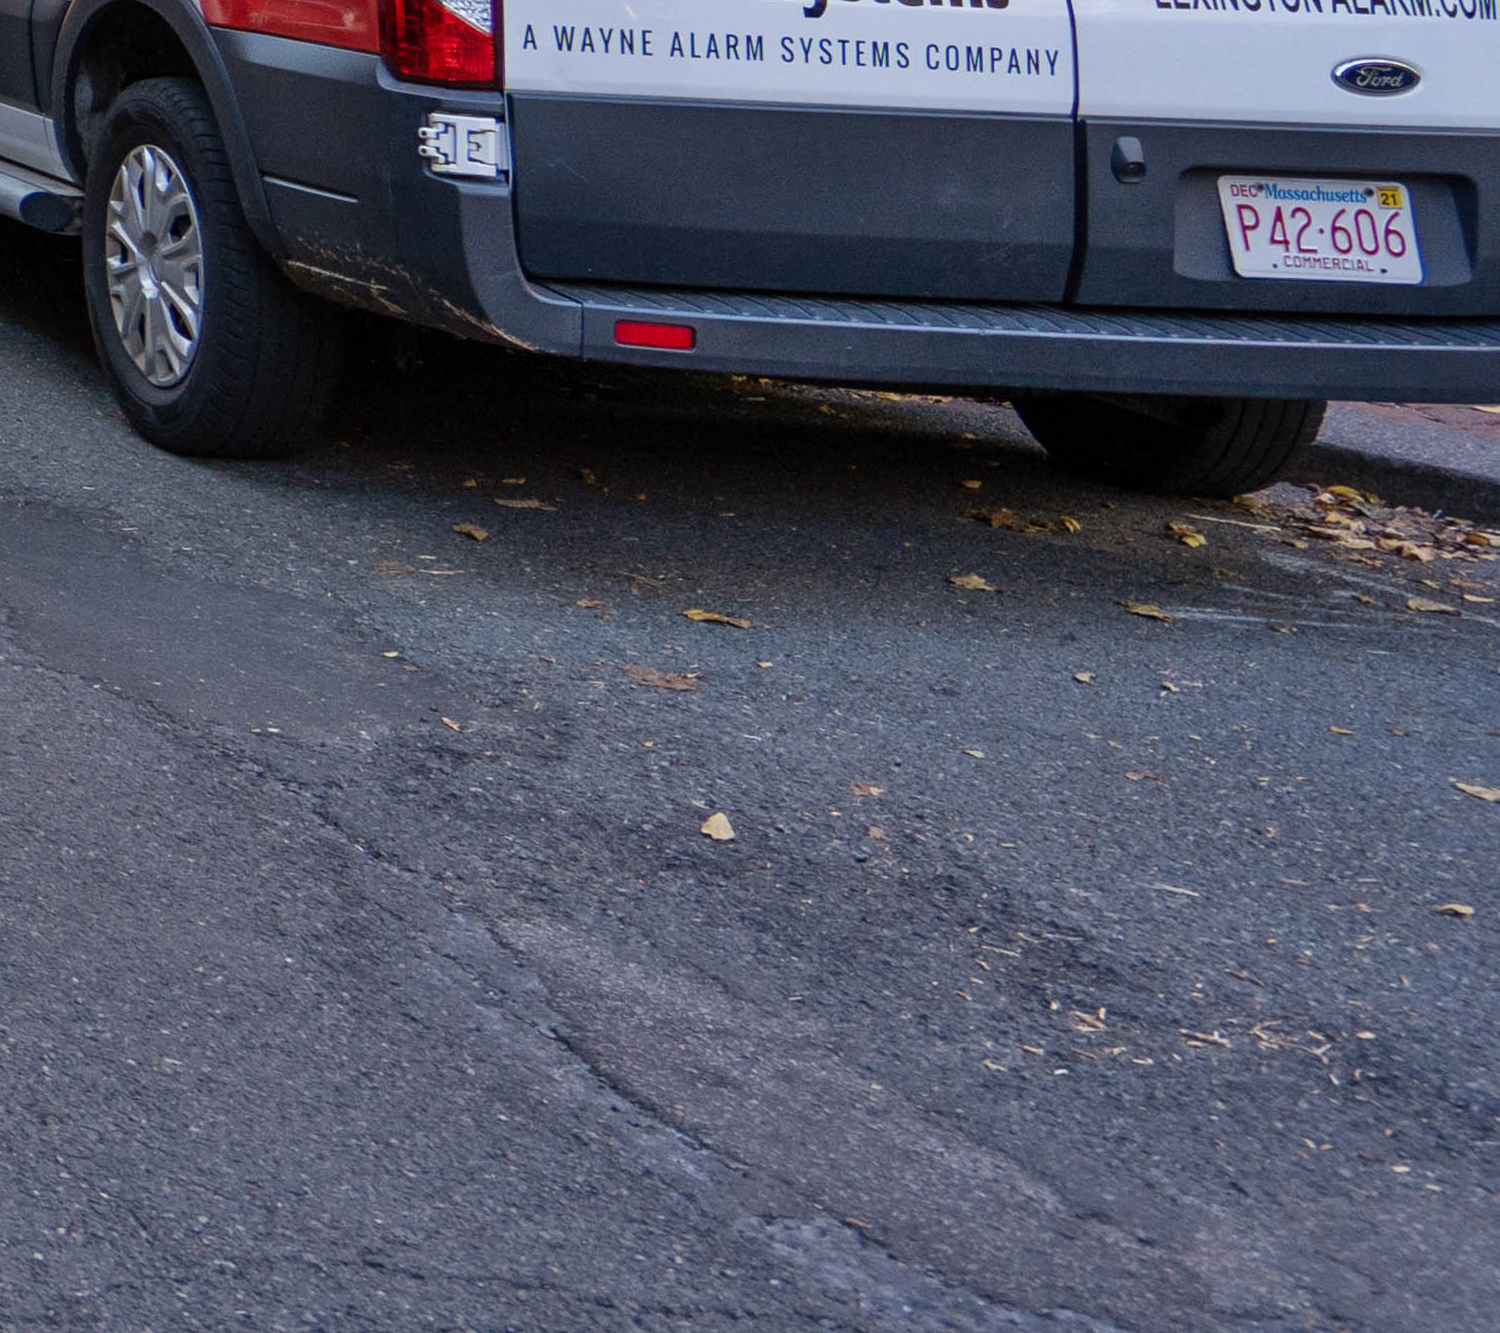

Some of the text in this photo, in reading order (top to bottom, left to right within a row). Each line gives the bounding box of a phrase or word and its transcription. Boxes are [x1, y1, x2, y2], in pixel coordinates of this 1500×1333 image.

[522, 24, 1060, 77] A WAYNE ALARM SYSTEMS COMPANY
[1355, 66, 1405, 88] Ford
[1230, 183, 1398, 206] DEC Massachusetts 21
[1283, 255, 1375, 272] COMMERCIAL
